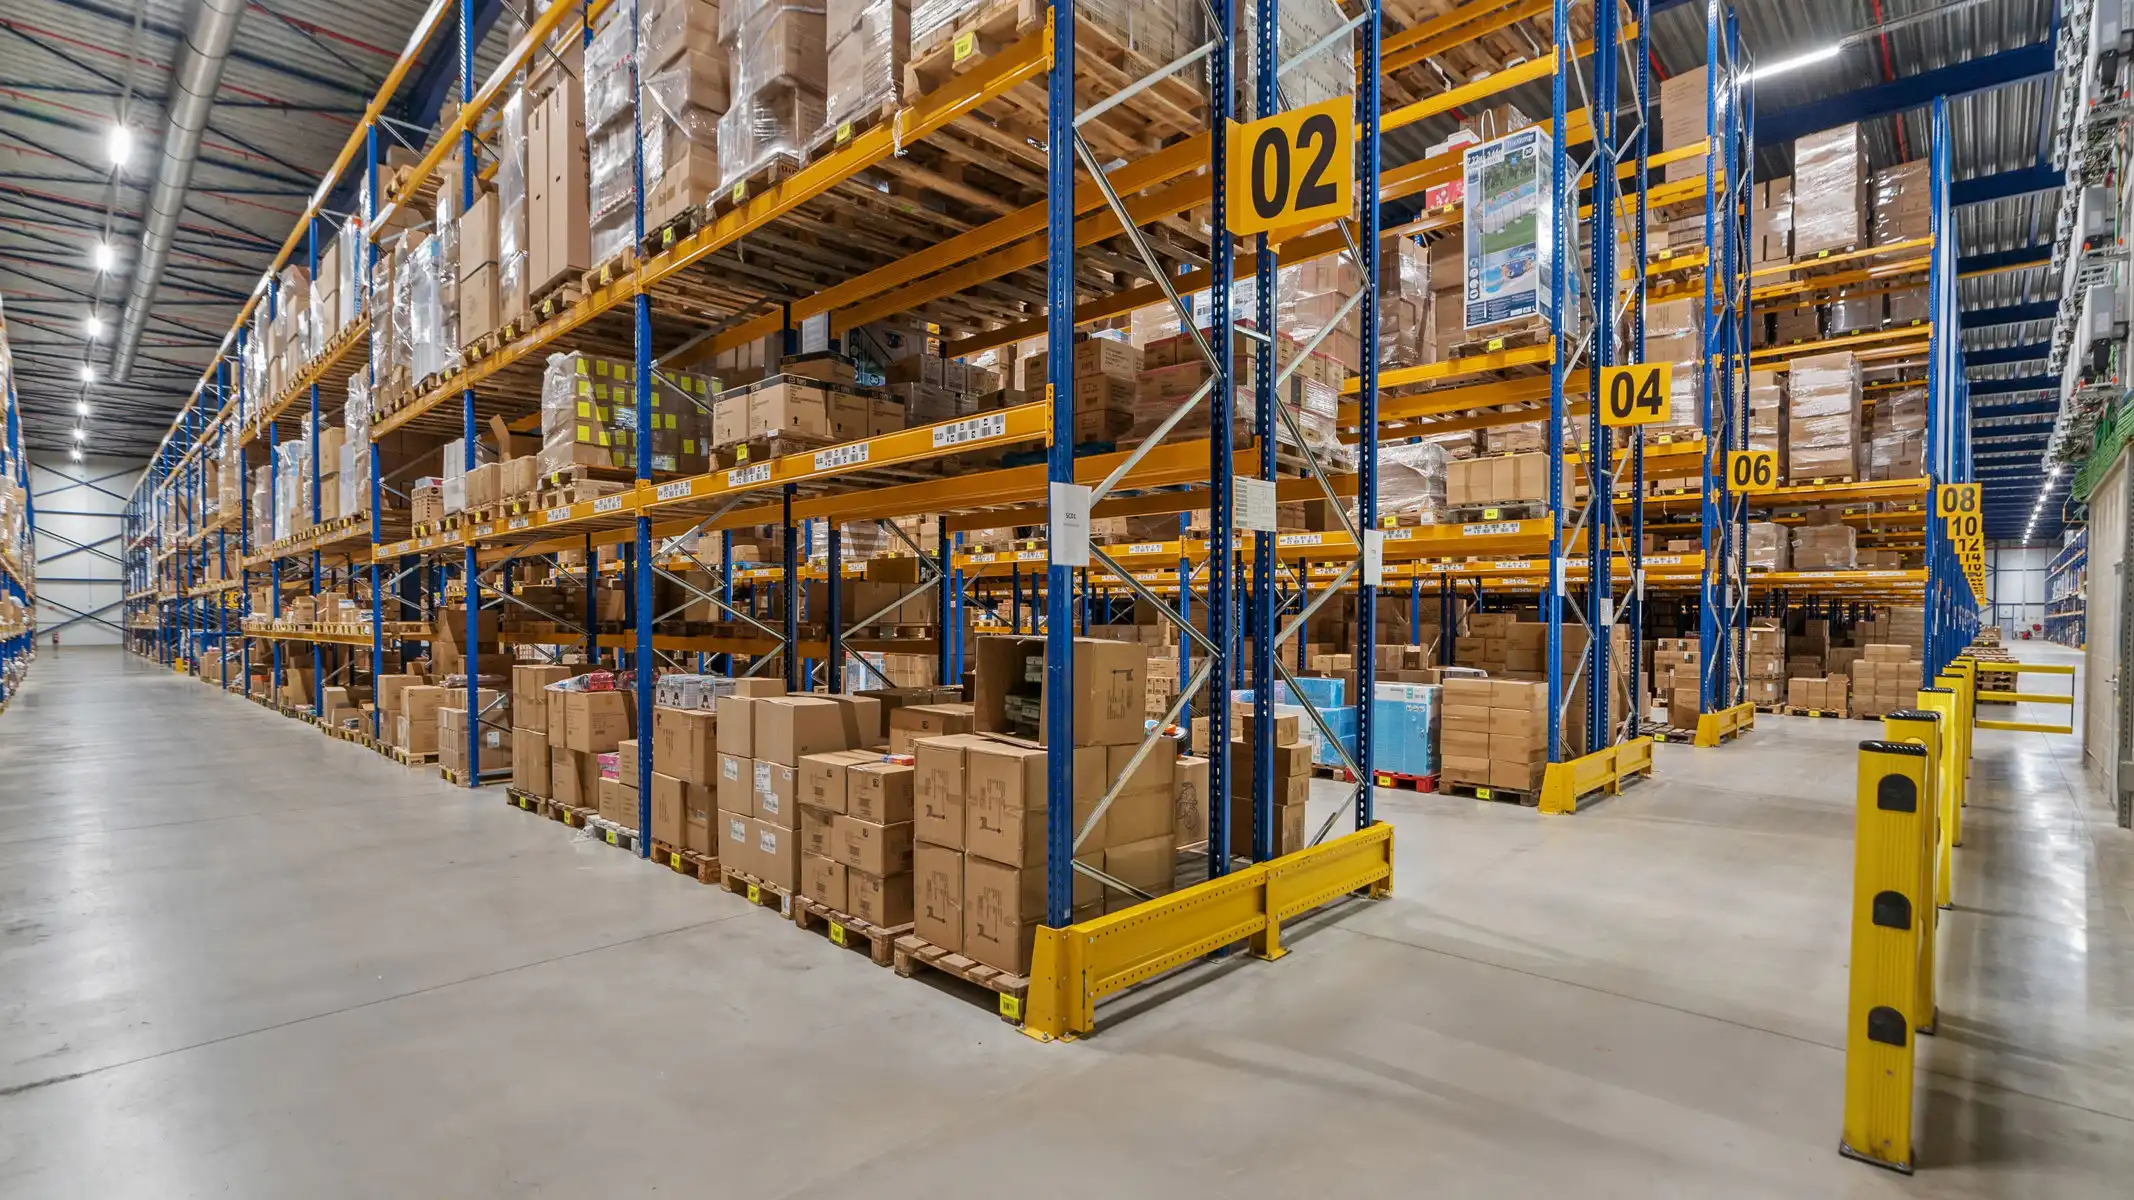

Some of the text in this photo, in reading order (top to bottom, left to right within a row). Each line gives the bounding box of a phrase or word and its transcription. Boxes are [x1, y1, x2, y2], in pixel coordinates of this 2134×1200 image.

[1251, 113, 1338, 219] 02
[1610, 368, 1663, 418] 04
[1734, 454, 1771, 486] 06
[1942, 487, 1975, 513] 08
[1952, 516, 1978, 537] 10
[1958, 539, 1980, 552] 12
[1965, 553, 1981, 563] 14
